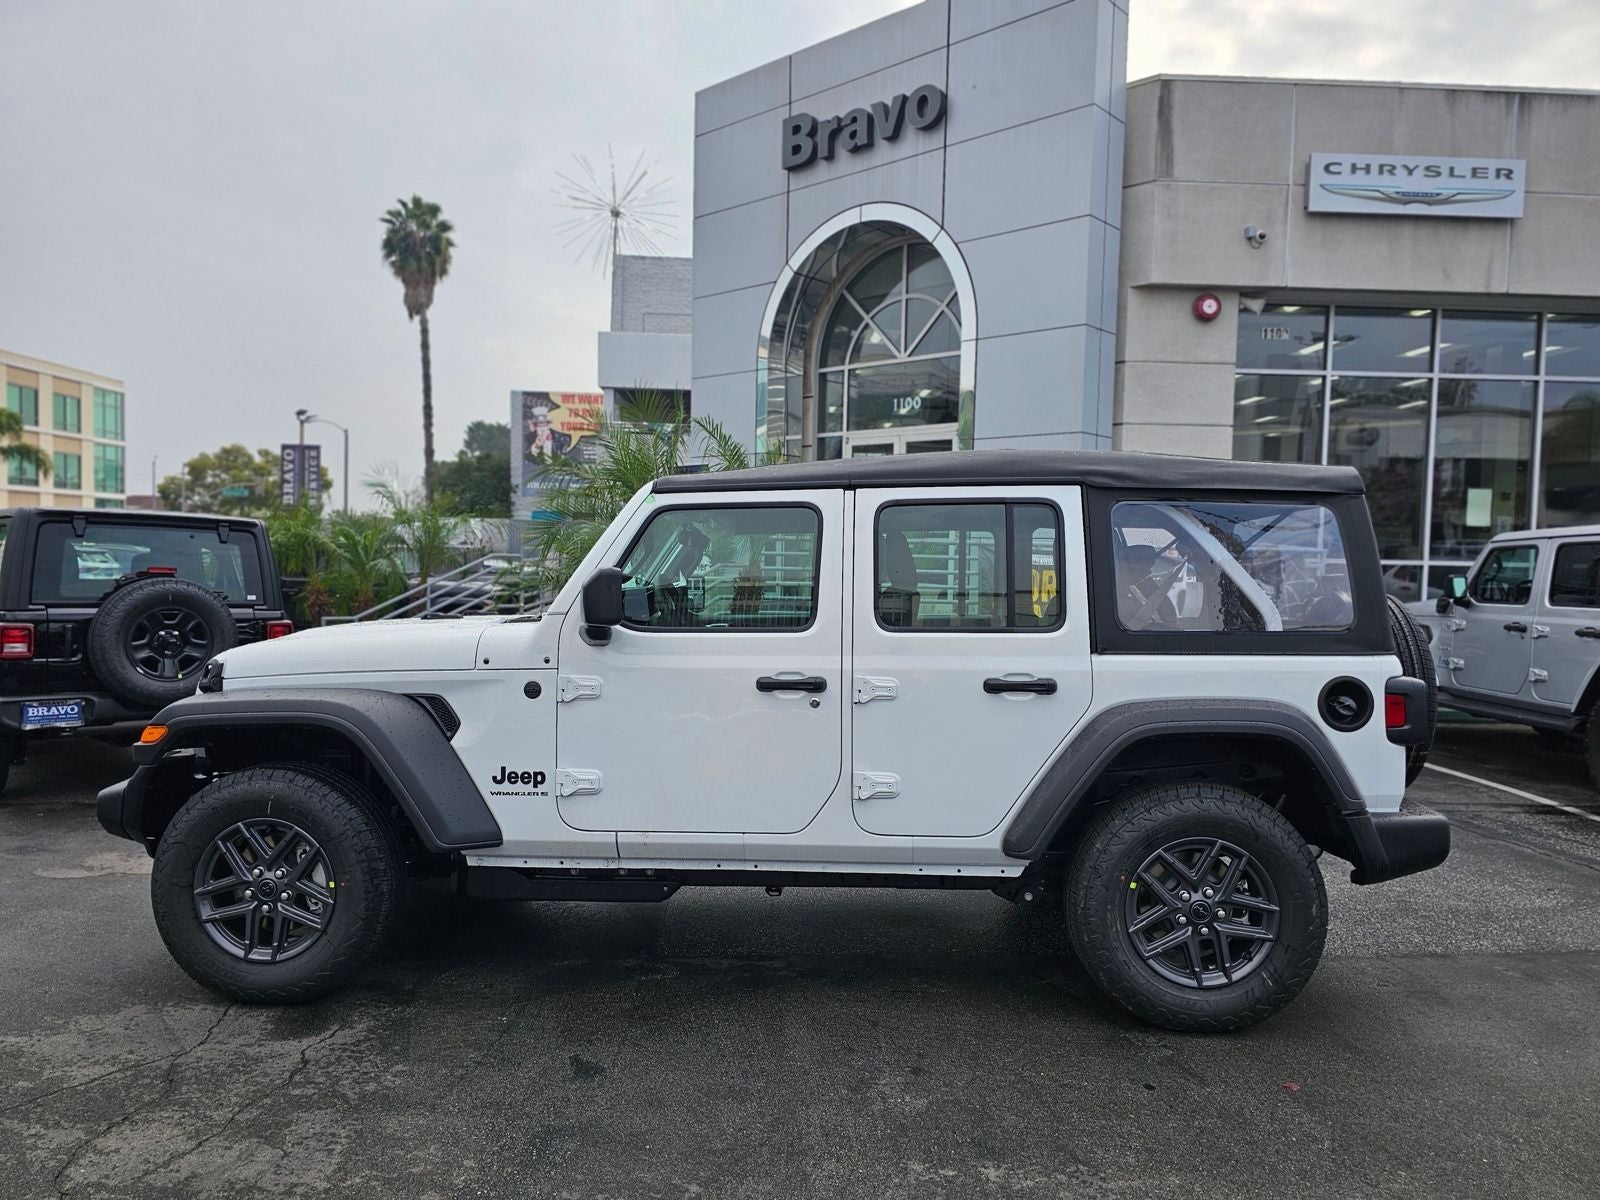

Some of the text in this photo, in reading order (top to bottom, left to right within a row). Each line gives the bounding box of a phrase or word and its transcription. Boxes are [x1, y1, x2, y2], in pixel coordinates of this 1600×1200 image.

[782, 84, 948, 171] Bravo
[1323, 162, 1515, 180] CHRYSLER
[561, 393, 575, 404] WE
[893, 396, 921, 411] 1100
[27, 705, 78, 716] BRAVO
[491, 766, 546, 788] Jeep
